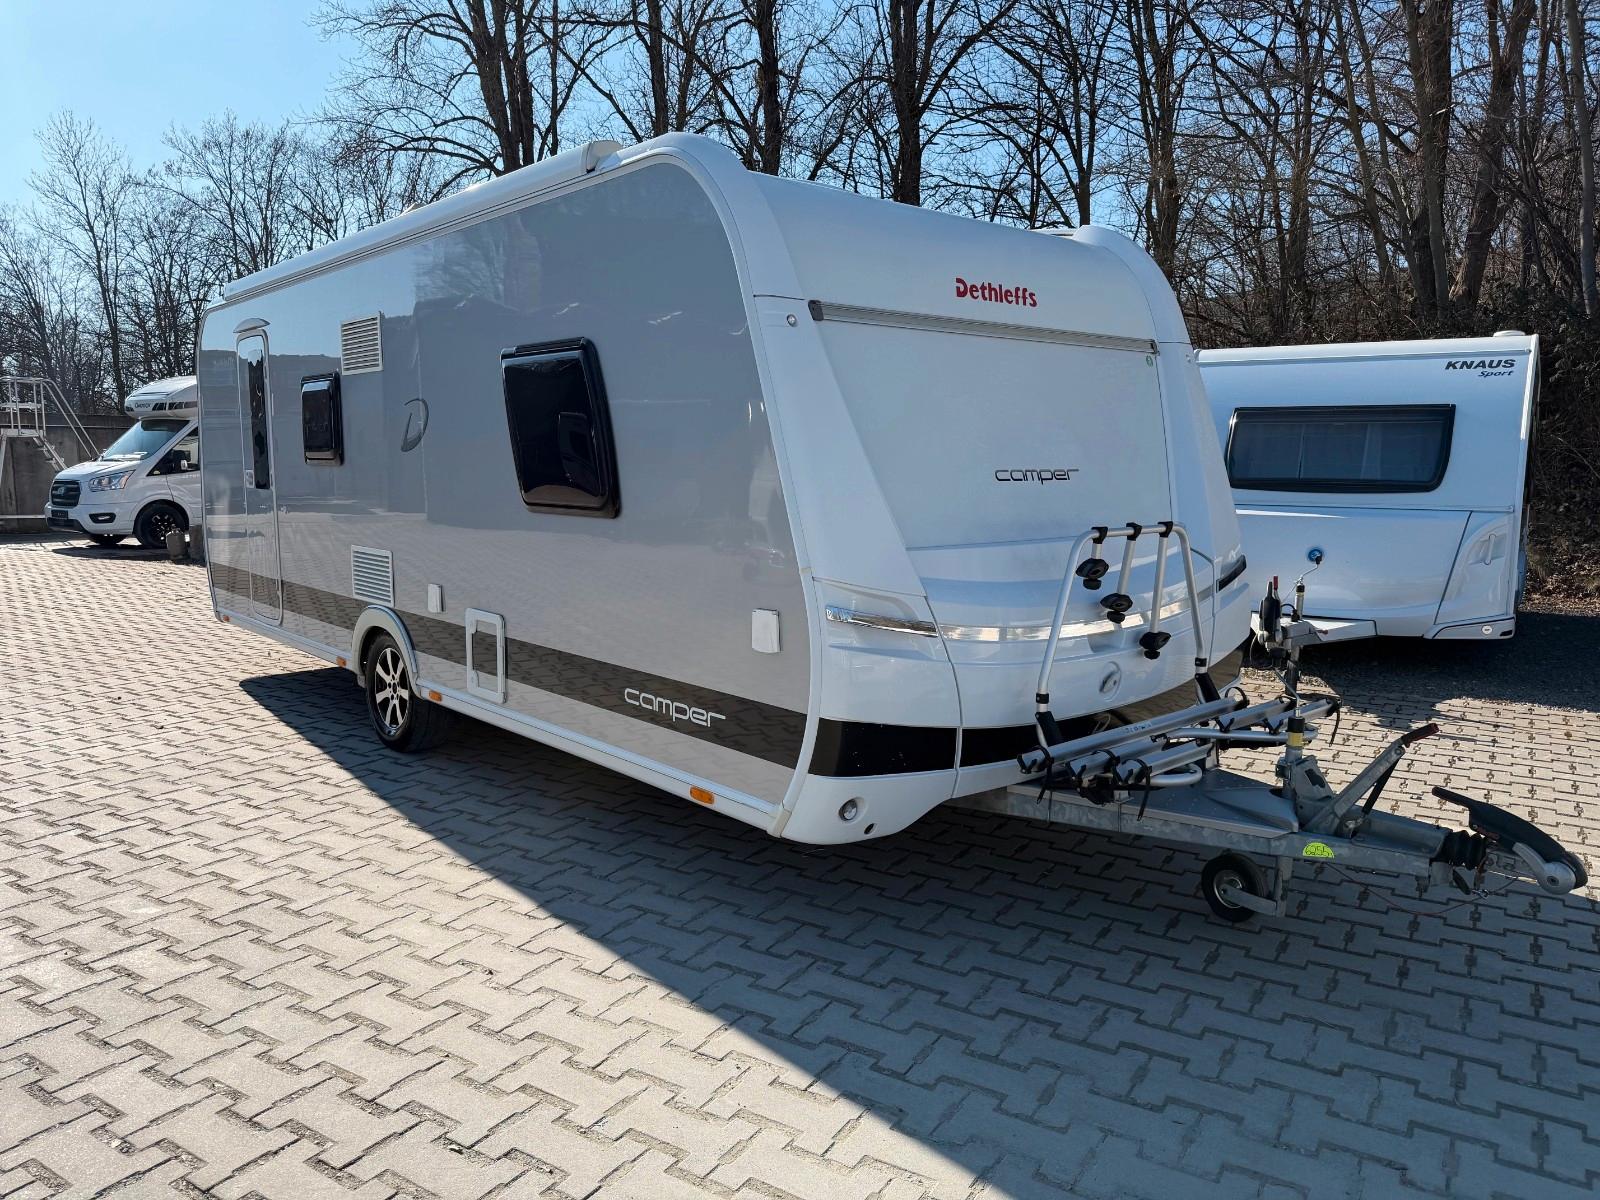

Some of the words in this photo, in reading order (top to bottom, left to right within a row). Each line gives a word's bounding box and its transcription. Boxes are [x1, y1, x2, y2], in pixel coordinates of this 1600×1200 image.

[955, 277, 1038, 308] Dethleffs
[1444, 359, 1516, 370] KNAUS
[1478, 370, 1515, 378] Sport
[994, 468, 1080, 485] camper
[624, 687, 727, 728] camper
